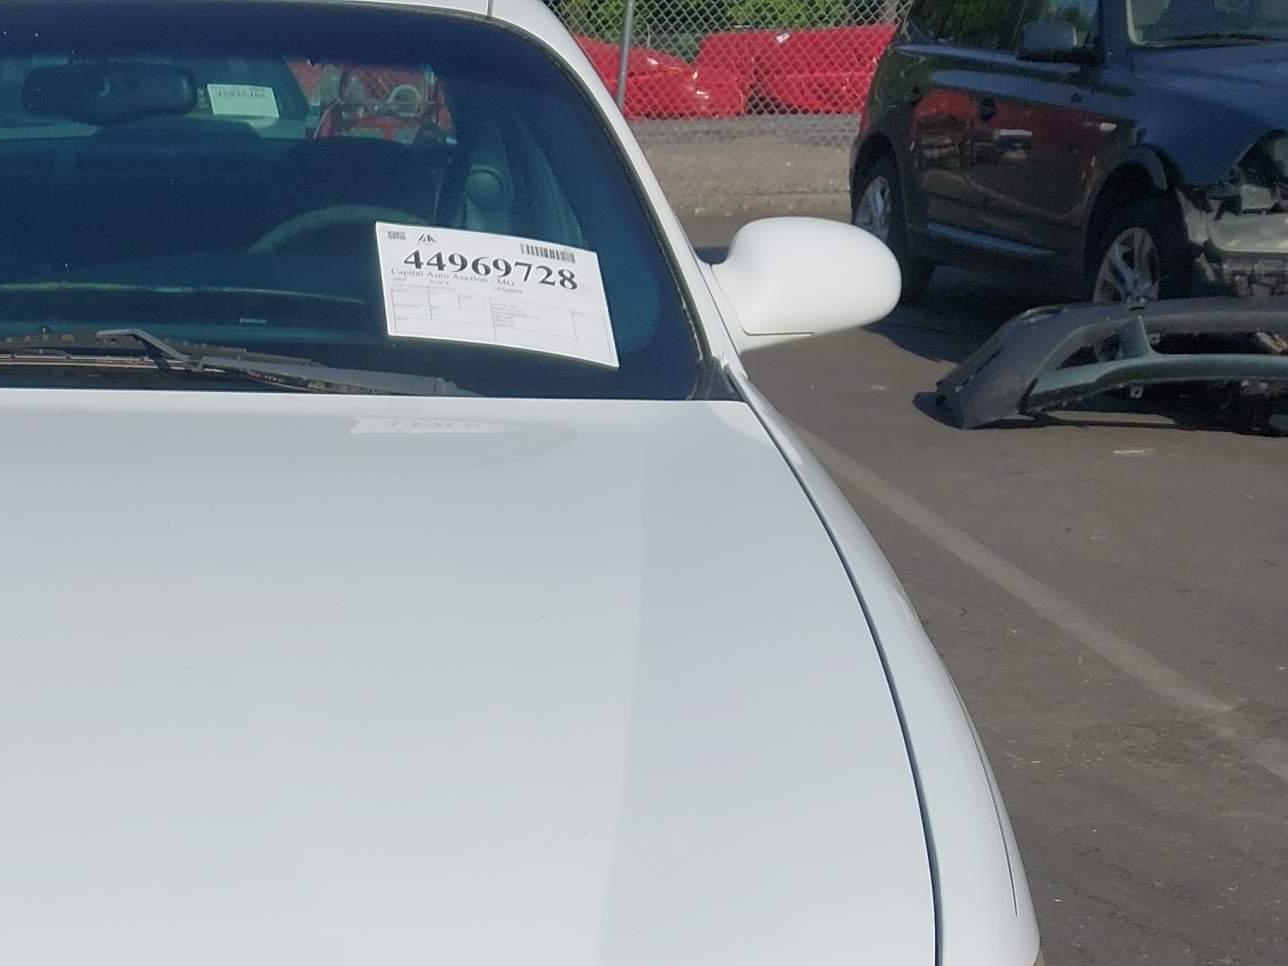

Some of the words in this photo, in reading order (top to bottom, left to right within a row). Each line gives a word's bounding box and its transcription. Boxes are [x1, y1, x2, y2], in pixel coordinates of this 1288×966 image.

[390, 269, 424, 278] Capital
[427, 271, 450, 280] Auto
[453, 273, 488, 284] Auction
[403, 249, 578, 290] 44969728
